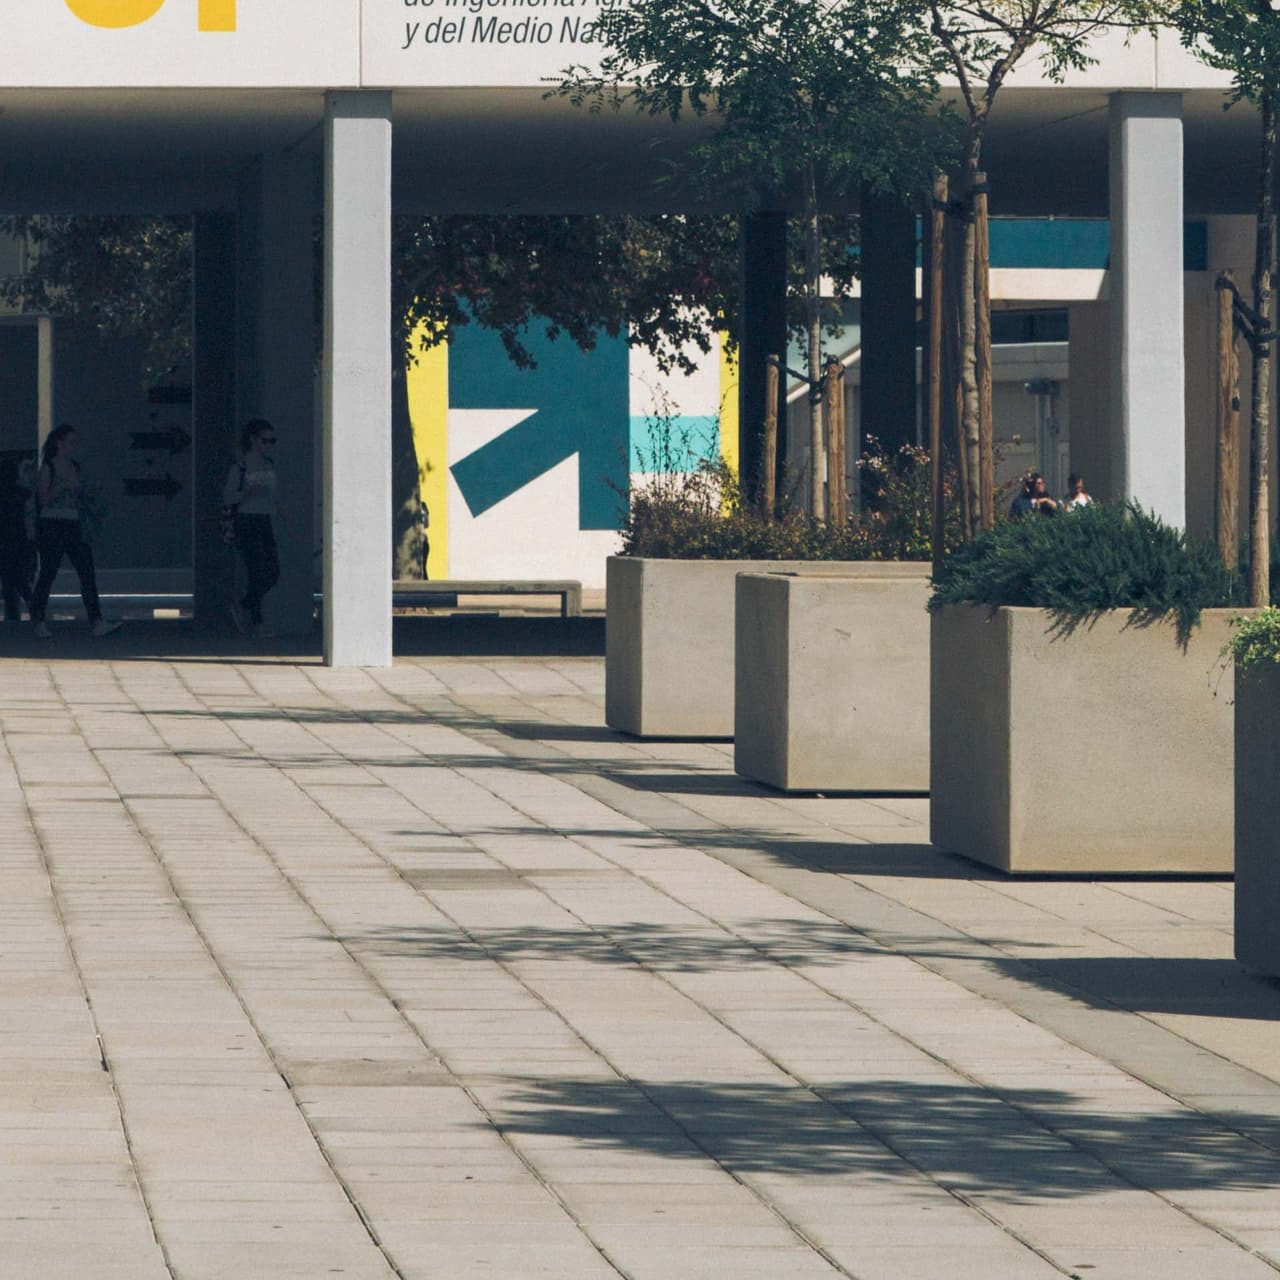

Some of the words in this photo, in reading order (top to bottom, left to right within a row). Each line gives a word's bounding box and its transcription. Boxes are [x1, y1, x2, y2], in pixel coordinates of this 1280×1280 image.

[401, 22, 420, 50] y
[424, 16, 466, 44] del
[471, 16, 553, 44] Medio
